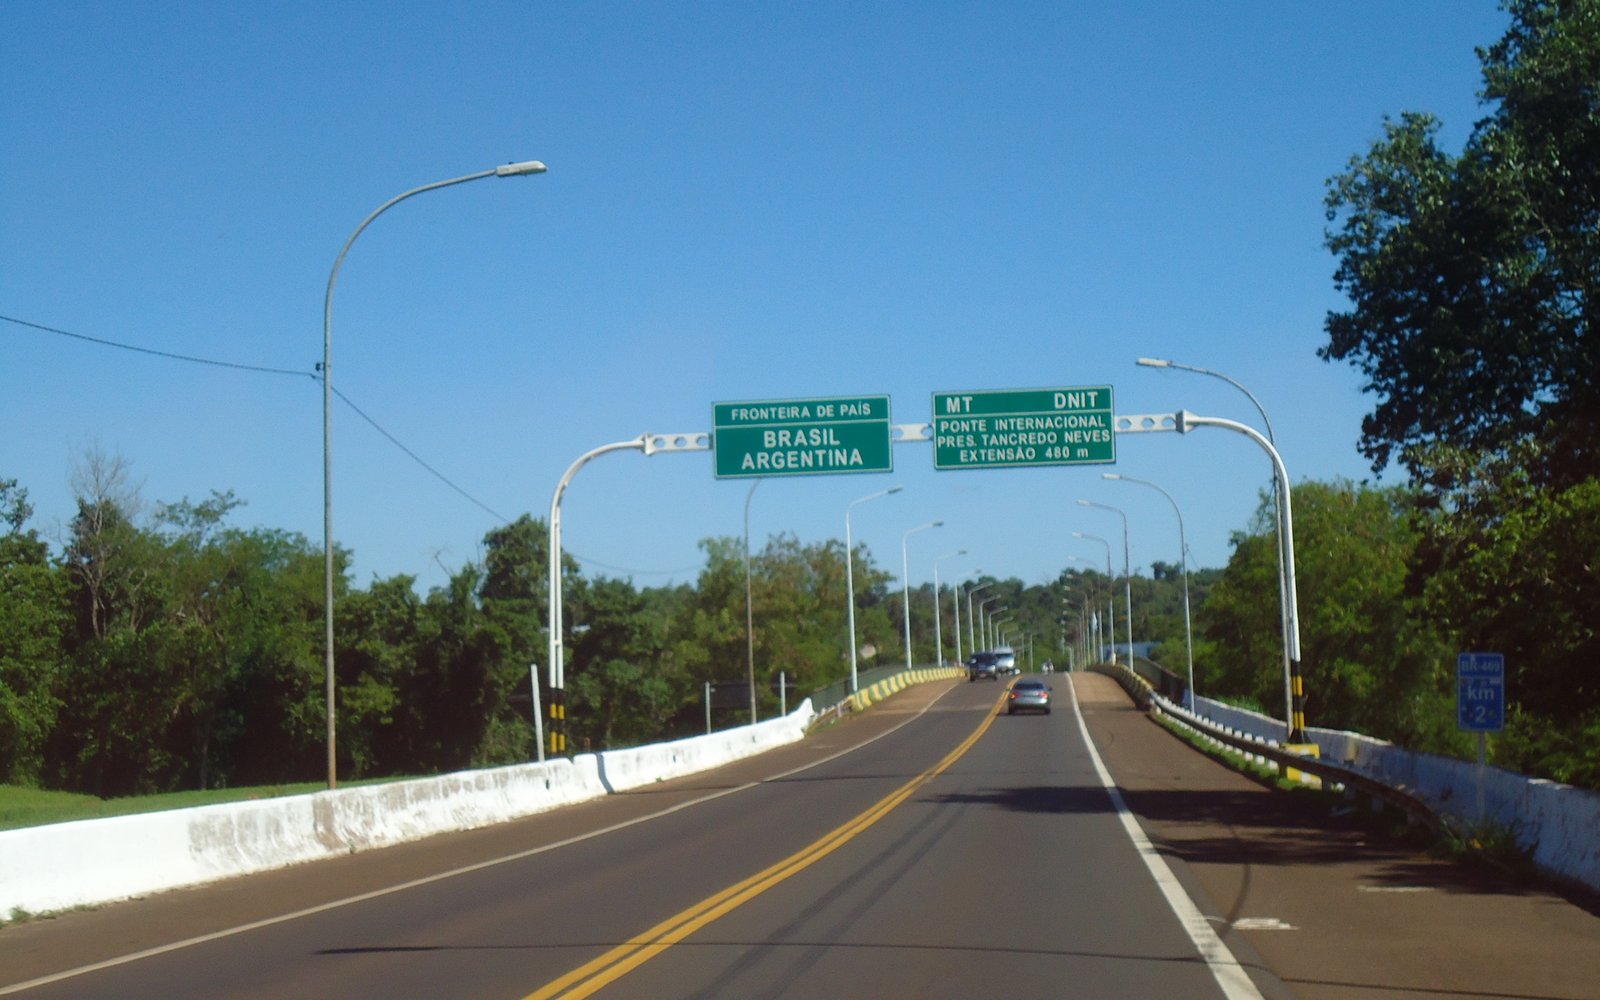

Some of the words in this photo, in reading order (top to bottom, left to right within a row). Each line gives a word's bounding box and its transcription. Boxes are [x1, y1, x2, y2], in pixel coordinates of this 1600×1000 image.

[946, 395, 973, 413] MT
[1054, 391, 1098, 409] DNIT
[731, 405, 811, 421] FRONTEIRA
[816, 404, 835, 418] DE
[840, 401, 871, 416] PAÍS
[940, 419, 987, 433] PONTE
[995, 415, 1106, 431] INTERNACIONAL
[763, 428, 840, 448] BRASIL
[937, 435, 977, 448] PRES.
[981, 432, 1058, 446] TANCREDO
[1064, 430, 1111, 443] NEVES
[741, 448, 864, 470] ARGENTINA
[959, 447, 1036, 463] EXTENSÃO
[1045, 446, 1070, 459] 480
[1077, 448, 1089, 458] m
[1467, 685, 1494, 699] km
[1475, 705, 1486, 722] 2
